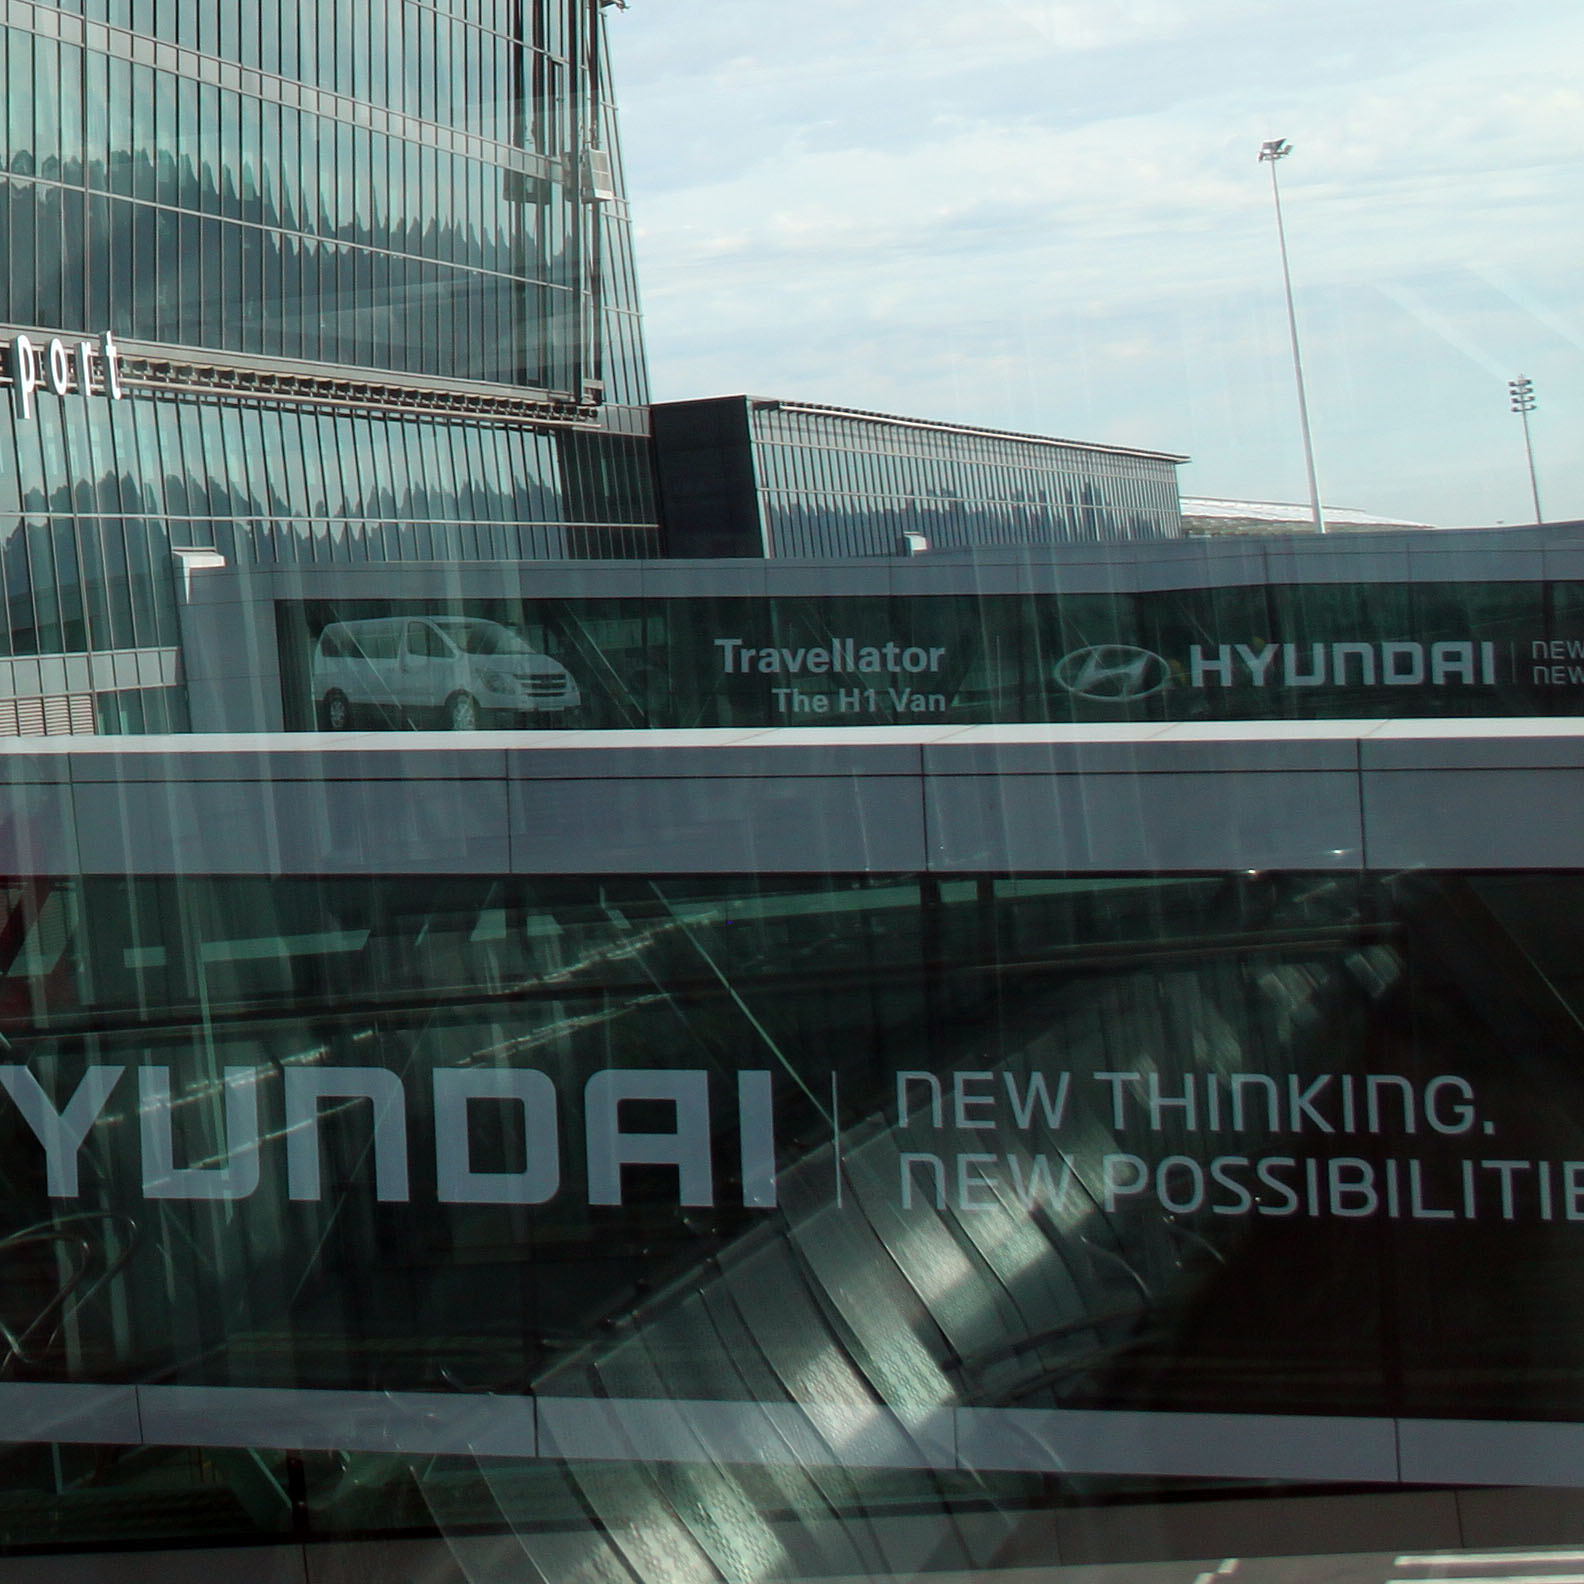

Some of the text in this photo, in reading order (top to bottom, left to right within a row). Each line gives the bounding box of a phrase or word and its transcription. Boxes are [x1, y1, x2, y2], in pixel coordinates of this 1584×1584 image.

[714, 637, 946, 674] Travellator
[1189, 640, 1495, 688] HYUNDAI
[1532, 640, 1584, 660] NEW
[1533, 665, 1584, 685] NEW
[772, 688, 946, 713] The H1 Van
[896, 1070, 1497, 1135] NEW THINKING.
[900, 1152, 1077, 1212] NEW
